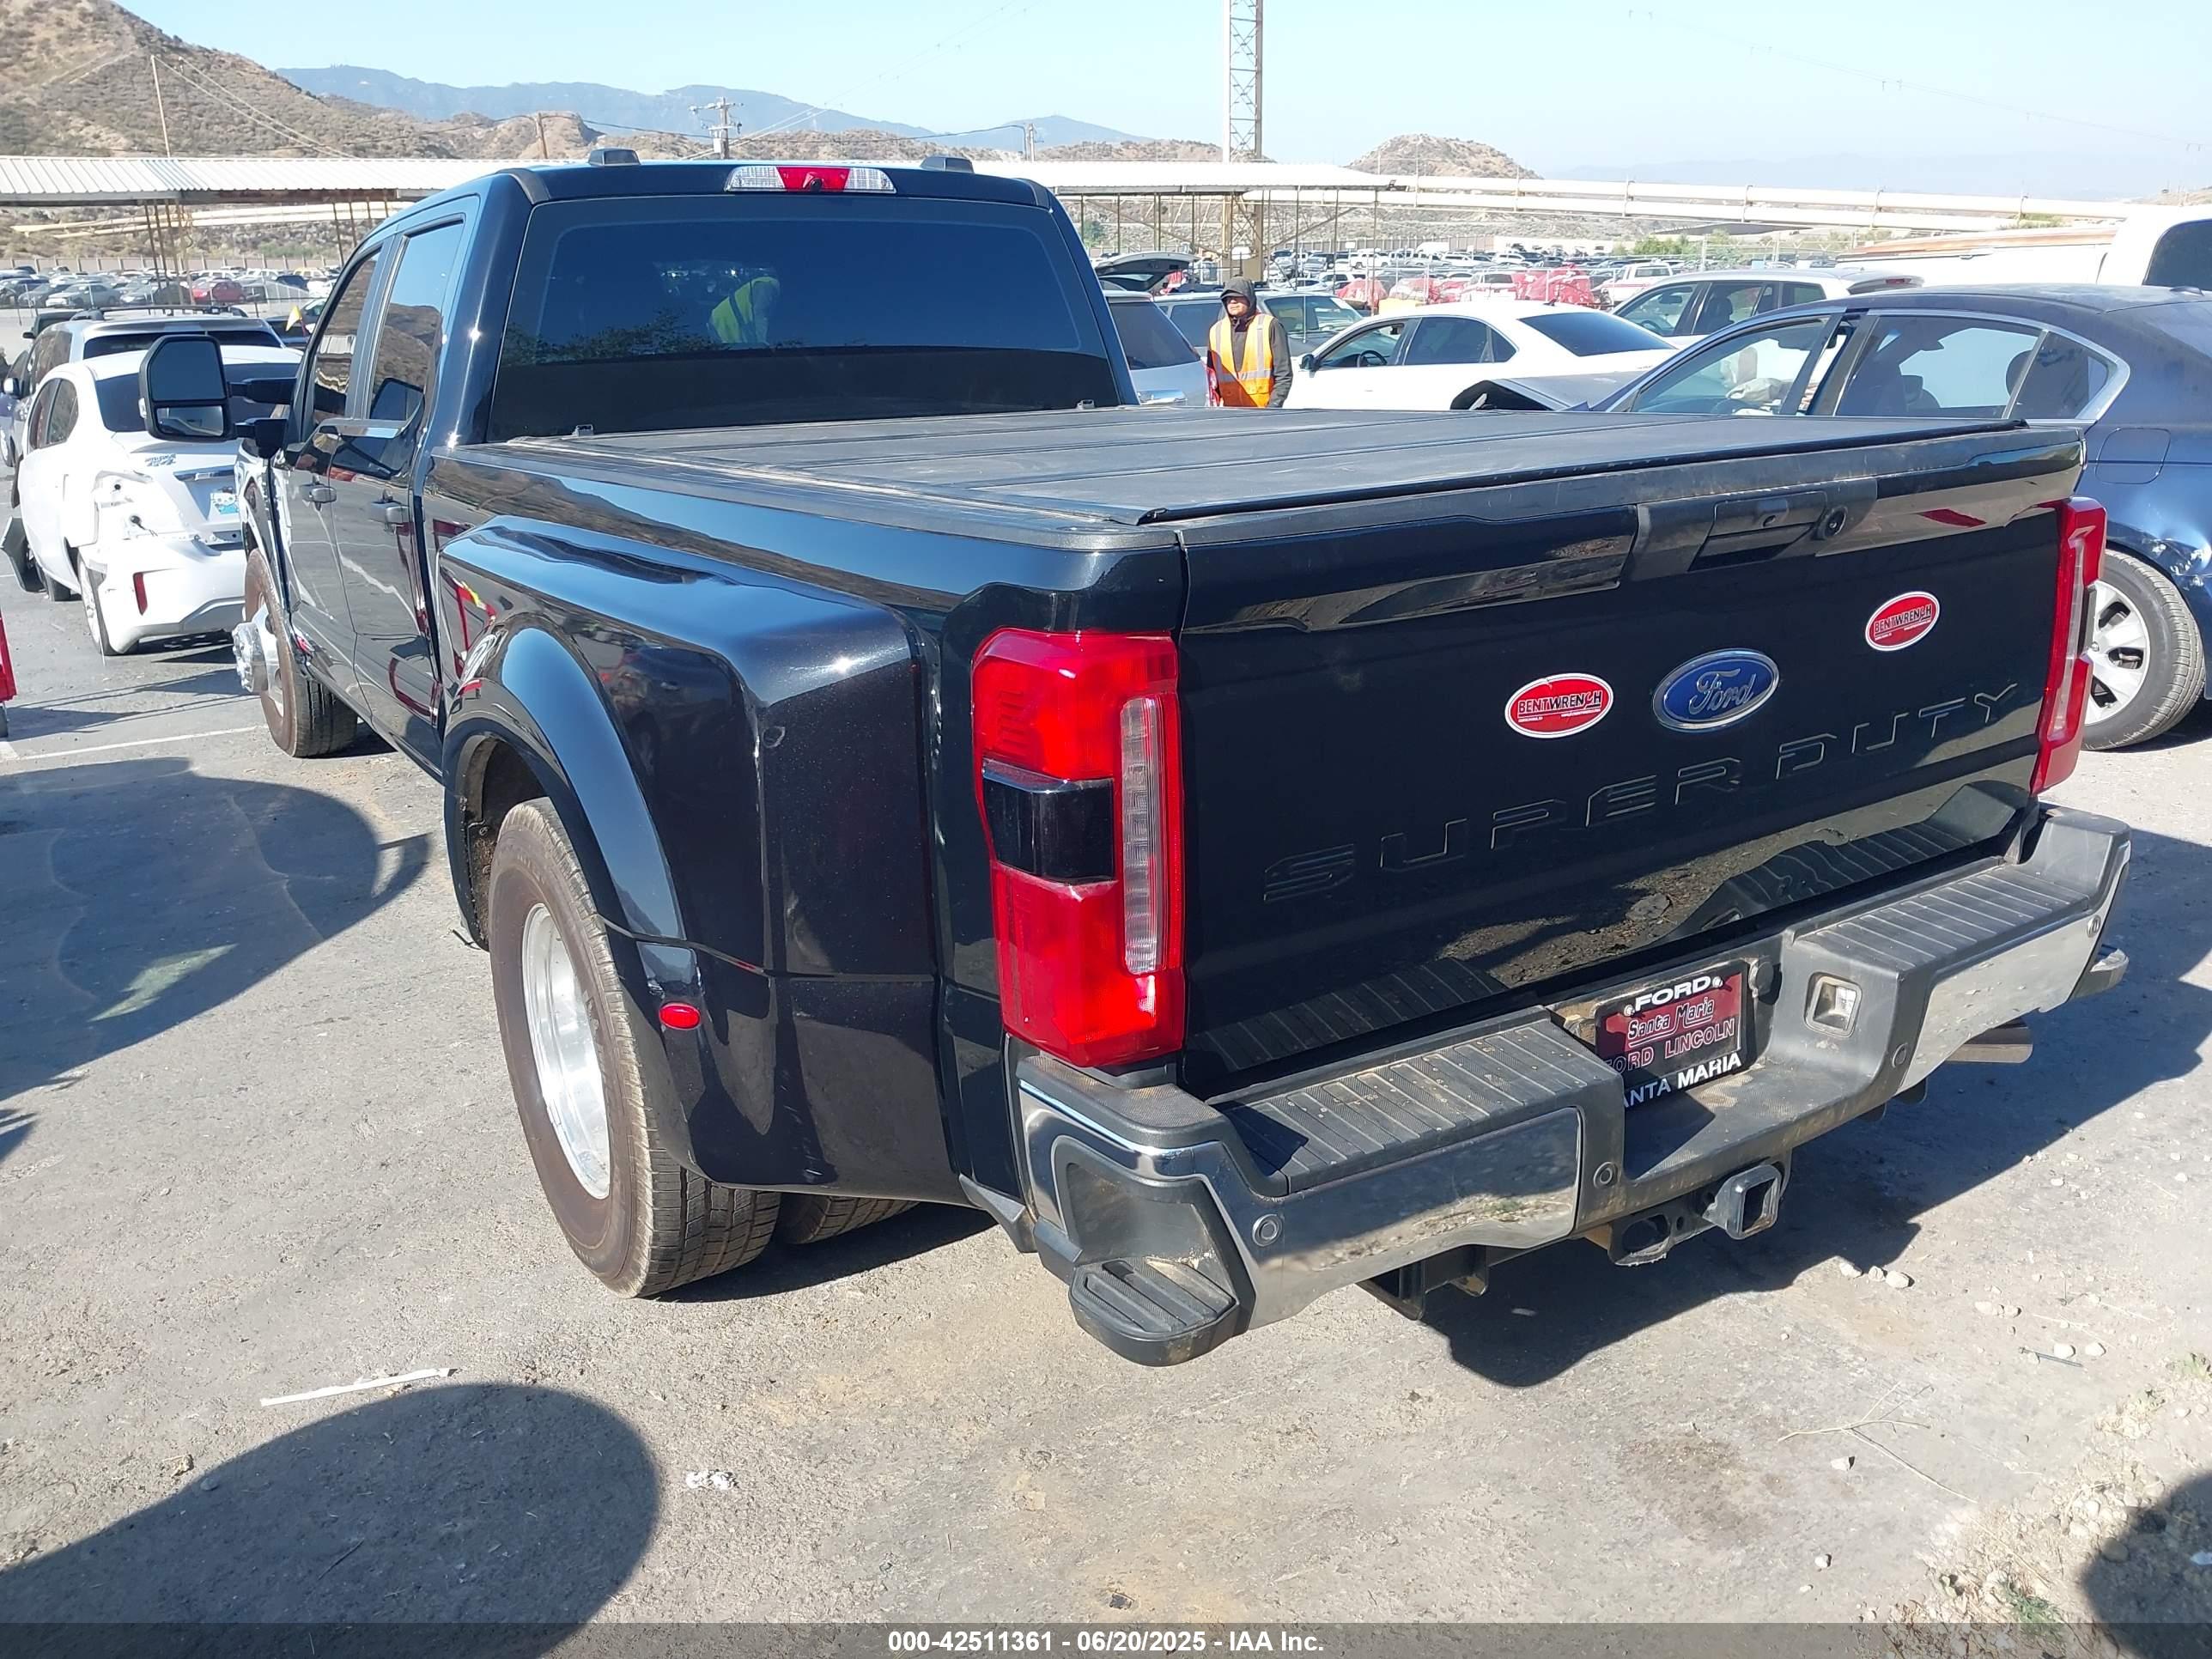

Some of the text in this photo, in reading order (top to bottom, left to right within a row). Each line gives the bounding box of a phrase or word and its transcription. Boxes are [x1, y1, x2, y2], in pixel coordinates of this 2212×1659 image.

[1874, 604, 1933, 634] BENTWRENCH
[1517, 690, 1603, 716] BENTWRENCH
[1688, 667, 1757, 715] Ford
[1263, 682, 2018, 902] SUPER DUTY
[1635, 975, 1711, 1012] FORD
[1627, 996, 1715, 1040] Santa Maria
[1664, 1018, 1735, 1059] LINCOLN
[1677, 1052, 1742, 1089] MARIA
